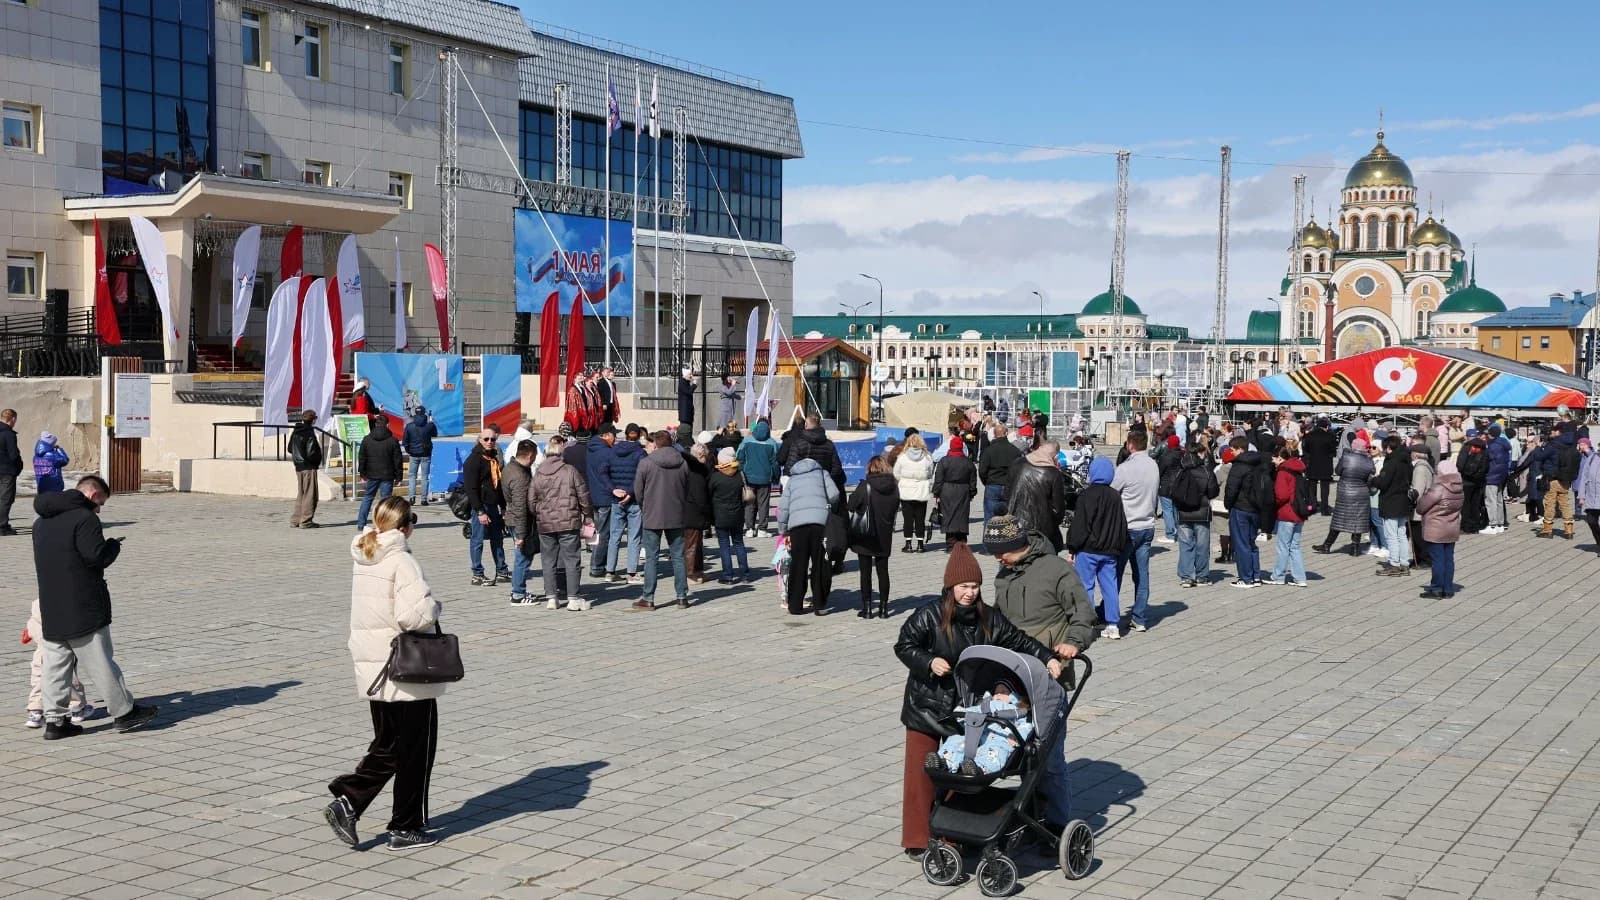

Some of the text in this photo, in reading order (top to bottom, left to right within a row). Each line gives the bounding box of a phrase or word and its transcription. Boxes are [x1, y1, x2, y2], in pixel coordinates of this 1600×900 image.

[552, 249, 601, 273] 1 МАЯ
[435, 358, 448, 390] 1
[1374, 357, 1417, 402] 9
[1395, 394, 1422, 403] МАЯ
